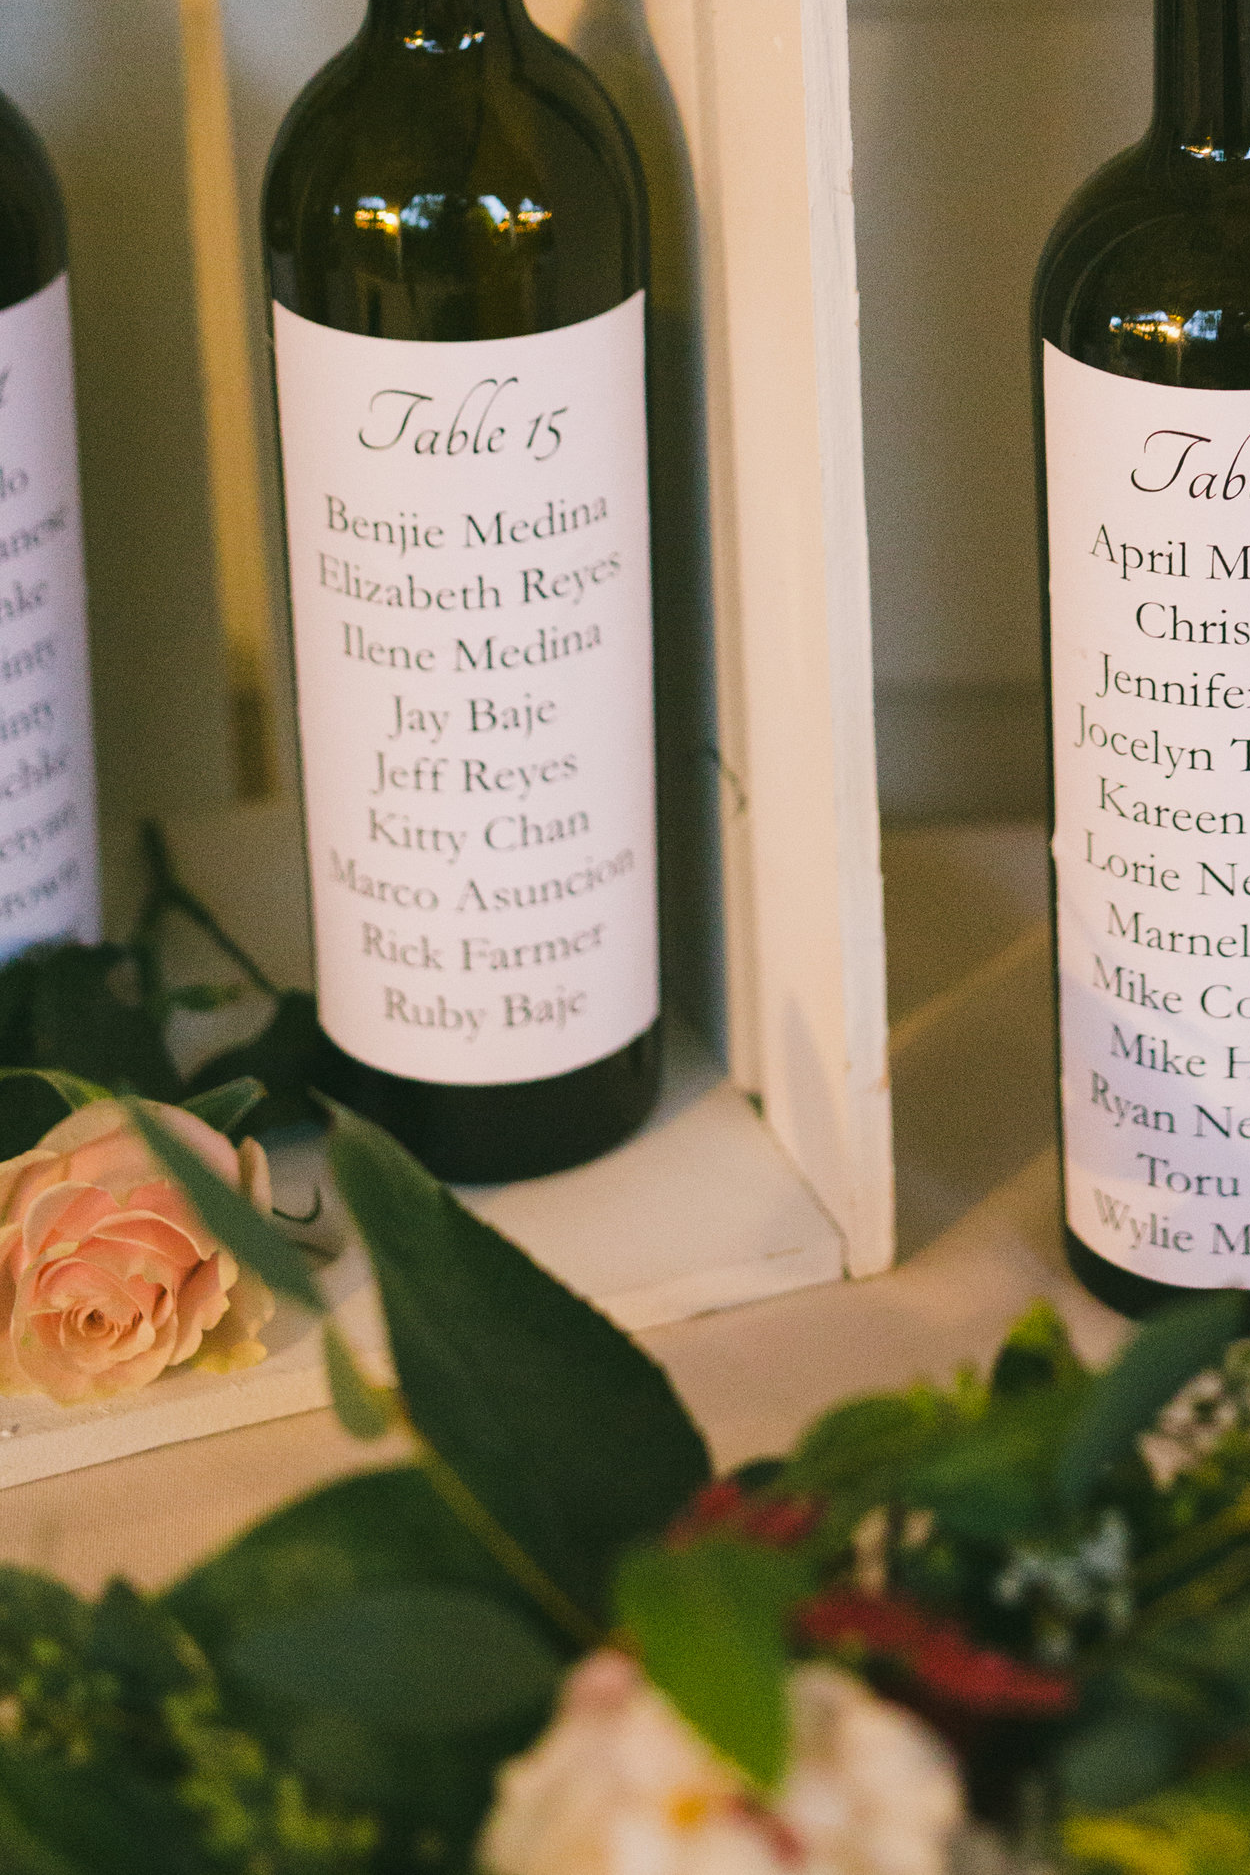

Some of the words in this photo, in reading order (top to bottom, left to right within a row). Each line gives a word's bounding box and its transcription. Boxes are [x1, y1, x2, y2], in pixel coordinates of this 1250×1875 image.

[357, 377, 519, 457] Table
[526, 406, 569, 462] 15
[324, 494, 446, 555] Benjie
[462, 494, 609, 549] Medina
[1089, 523, 1190, 581] April
[317, 552, 502, 612] Elizabeth
[519, 550, 624, 605] Reyes
[342, 622, 435, 673] Ilene
[453, 621, 604, 673] Medina
[1135, 601, 1250, 646] Chris
[387, 694, 450, 743] Jay
[467, 694, 557, 743] Baje
[1074, 702, 1215, 779] Jocelyn
[369, 751, 448, 796] Jeff
[461, 749, 580, 802] Reyes
[1097, 775, 1247, 835] Kareen
[367, 808, 467, 865] Kitty
[484, 807, 592, 855] Chan
[1083, 828, 1181, 892] Lorie
[327, 847, 440, 913] Marco
[456, 847, 636, 914] Asuncion
[361, 922, 444, 971] Rick
[460, 922, 607, 973] Farmer
[1092, 953, 1183, 1014] Mike
[1110, 1023, 1208, 1077] Mike
[1089, 1069, 1177, 1135] Ryan
[1136, 1151, 1241, 1197] Toru
[1093, 1187, 1194, 1252] Wylie
